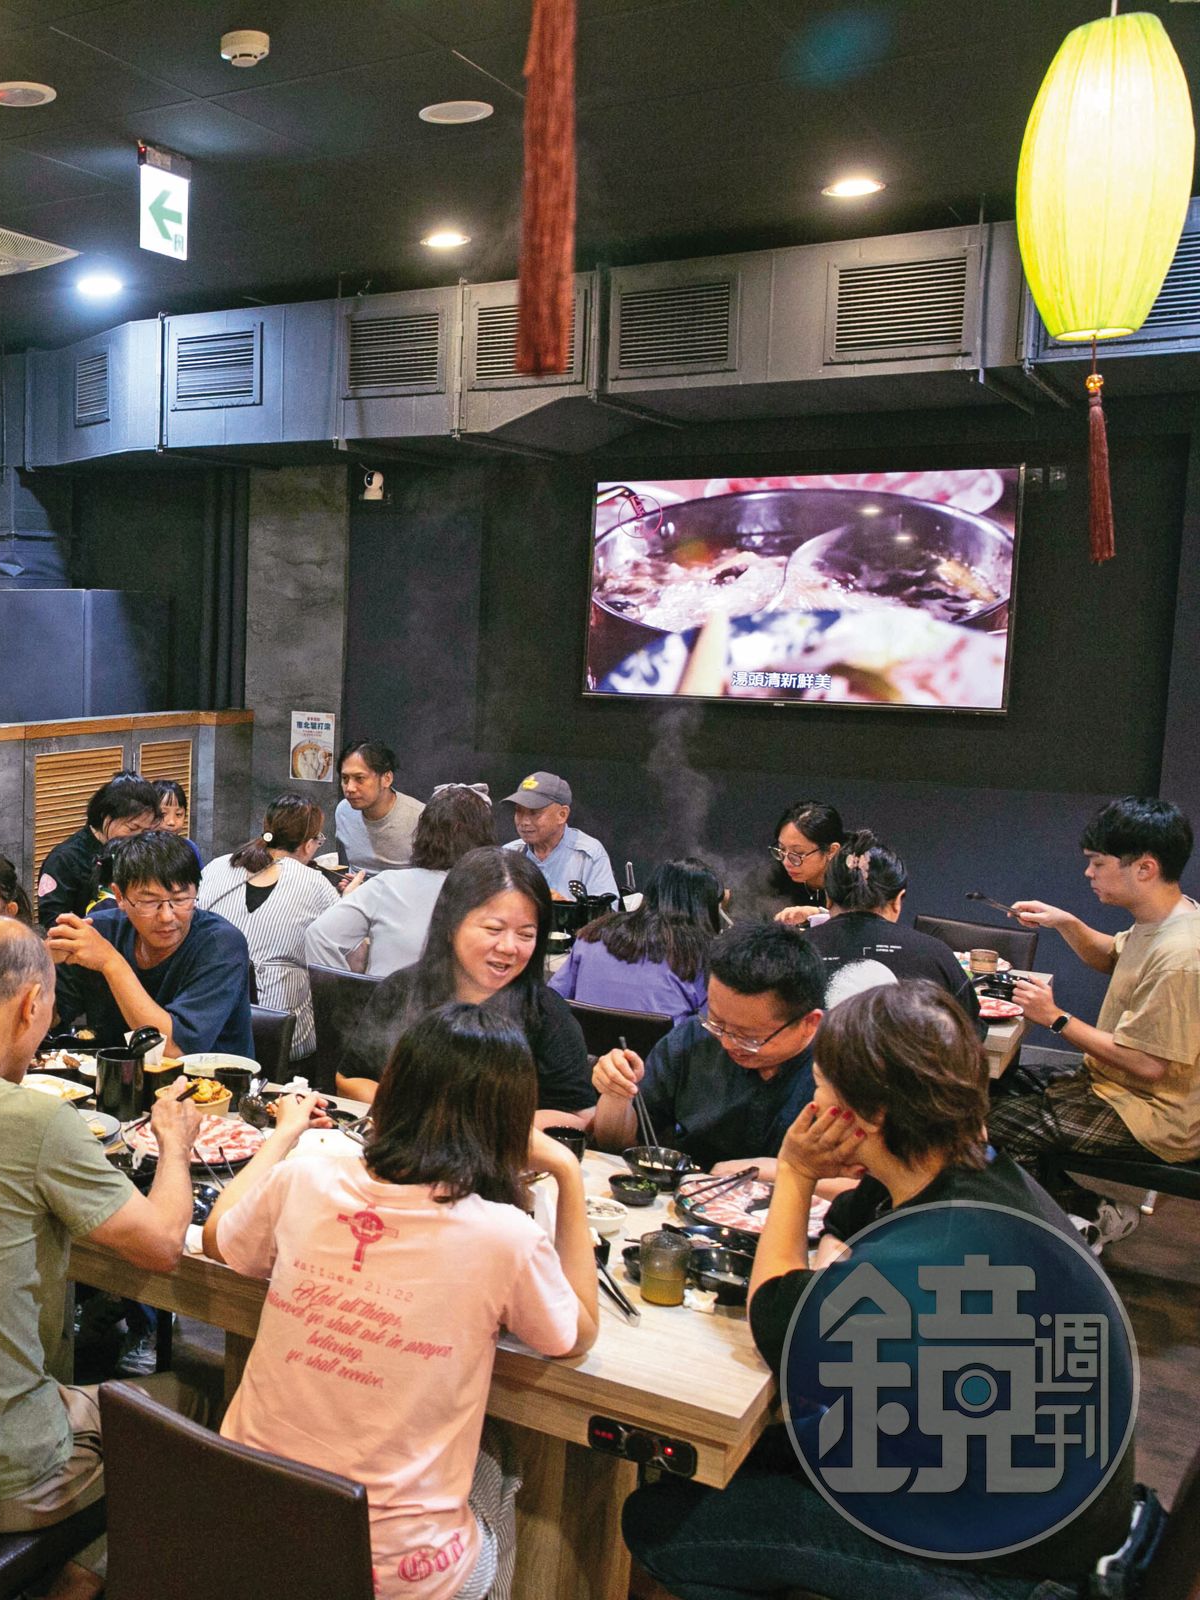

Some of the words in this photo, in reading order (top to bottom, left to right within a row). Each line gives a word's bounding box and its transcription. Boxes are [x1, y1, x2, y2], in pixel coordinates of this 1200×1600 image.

[732, 671, 832, 690] 湯頭清新鮮美
[363, 1280, 414, 1303] 21:22
[324, 1315, 363, 1336] shall
[285, 1348, 303, 1364] ye
[304, 1353, 341, 1374] shall
